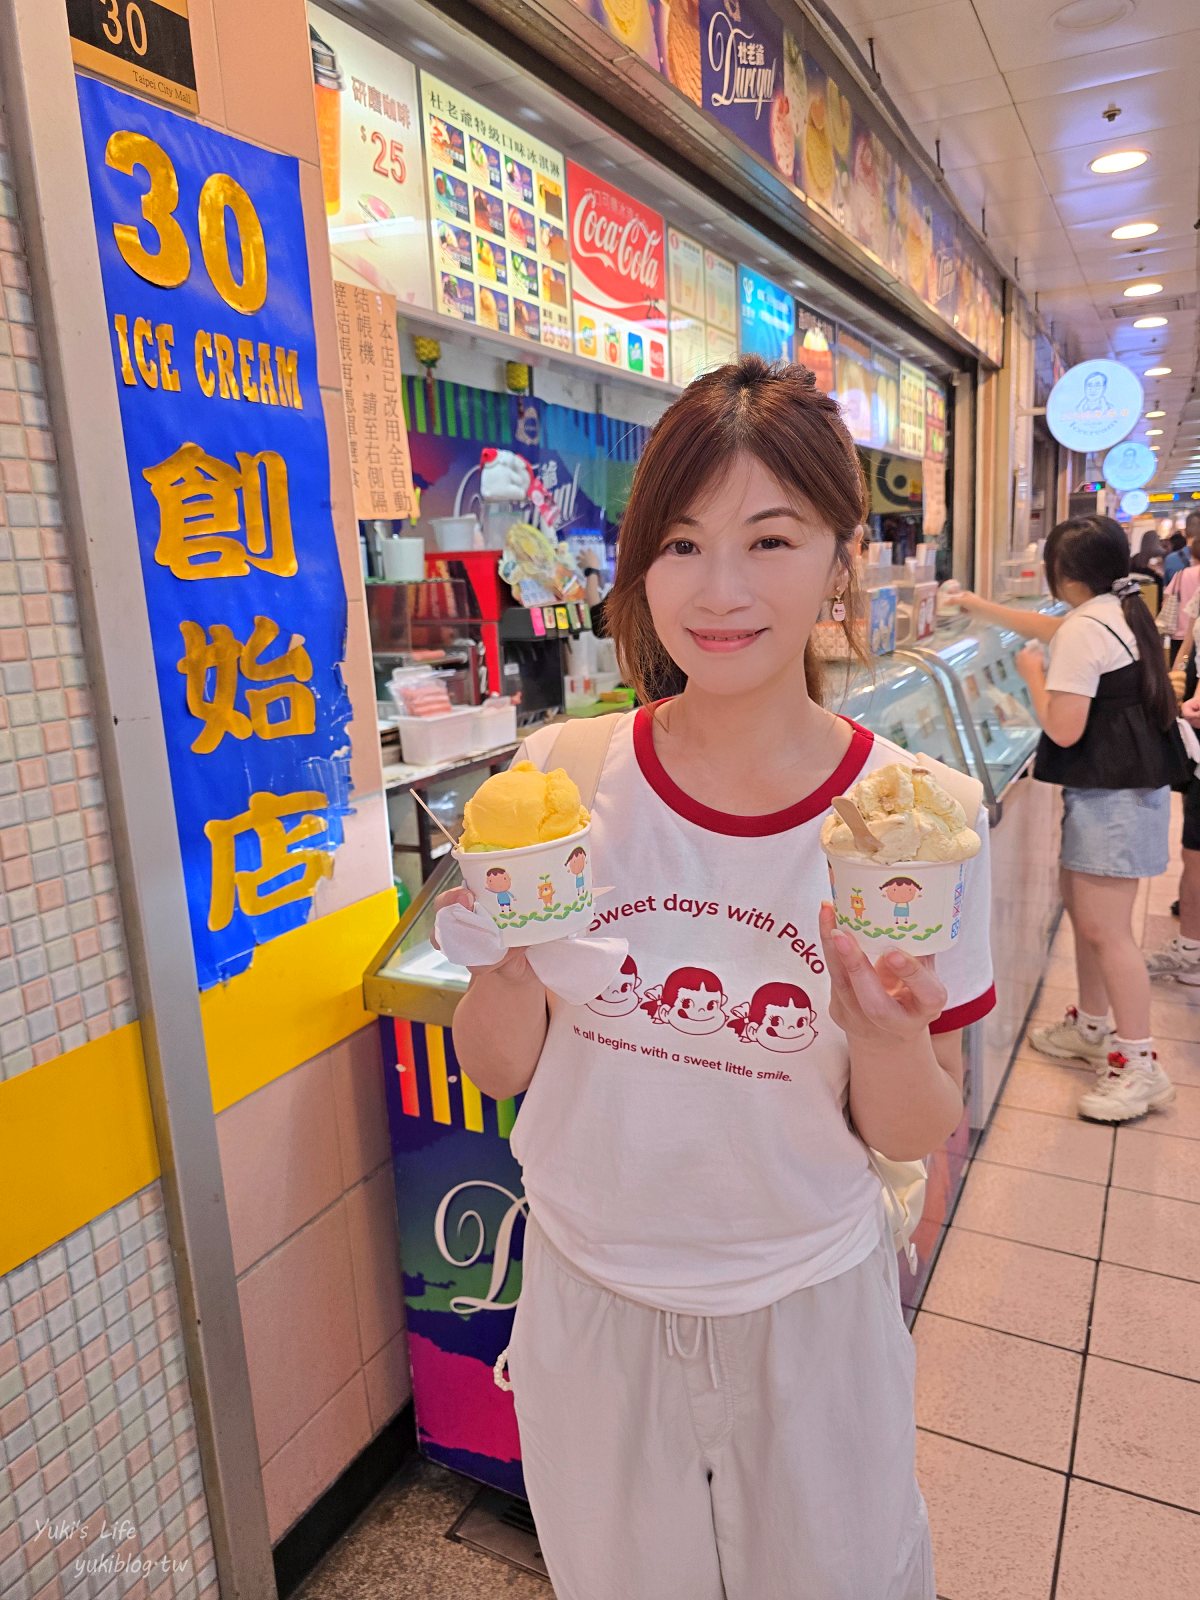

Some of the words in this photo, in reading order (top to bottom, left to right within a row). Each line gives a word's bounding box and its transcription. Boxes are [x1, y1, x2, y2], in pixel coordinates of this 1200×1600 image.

[102, 0, 148, 56] 30
[132, 70, 156, 90] Taipei
[157, 81, 174, 98] City
[175, 89, 192, 105] Mall
[105, 130, 268, 315] 30
[573, 192, 662, 290] Coca-Cola
[114, 314, 181, 392] ICE
[194, 329, 303, 410] CREAM
[378, 320, 413, 512] 本店已改用全自動
[142, 442, 335, 932] 創始店
[663, 893, 720, 918] days
[727, 905, 775, 933] with
[777, 922, 825, 975] Peko
[573, 1025, 581, 1036] It
[582, 1030, 595, 1041] all
[597, 1033, 637, 1052] begins
[640, 1046, 668, 1060] with
[671, 1053, 680, 1062] a
[683, 1055, 722, 1071] sweet
[725, 1061, 753, 1078] little
[756, 1070, 792, 1082] smile.
